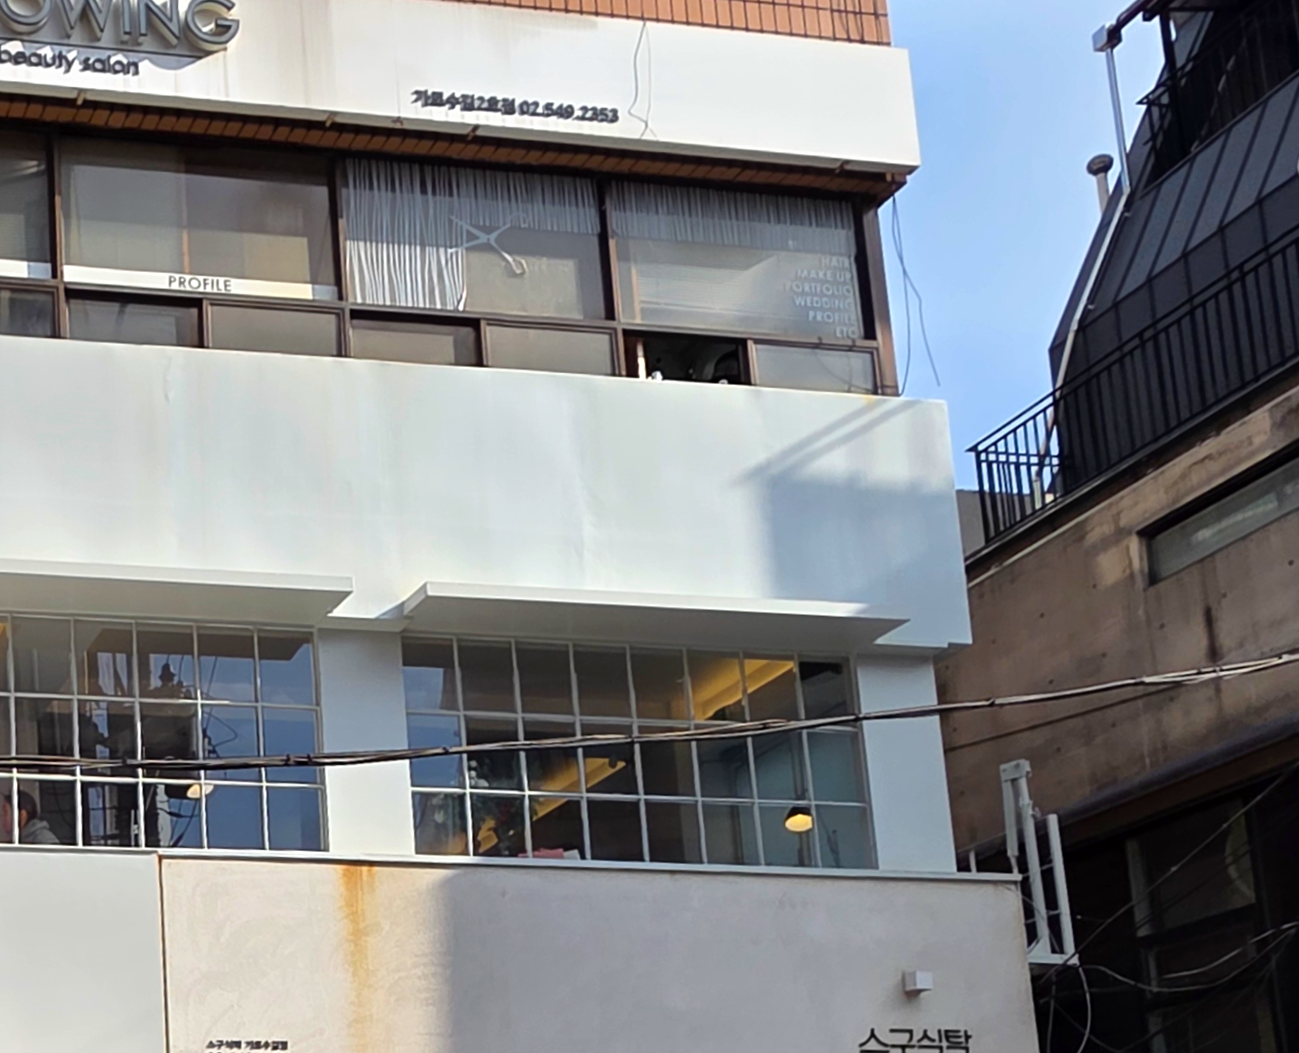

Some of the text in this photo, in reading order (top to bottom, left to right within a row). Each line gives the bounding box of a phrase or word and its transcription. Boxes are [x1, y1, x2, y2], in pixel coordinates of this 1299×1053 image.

[79, 55, 140, 77] salon
[518, 100, 619, 124] 02.549.2353
[168, 274, 233, 292] PROFILE
[797, 269, 834, 281] MAKE
[783, 281, 853, 295] PORTFOLIO
[794, 295, 853, 310] WEDDING
